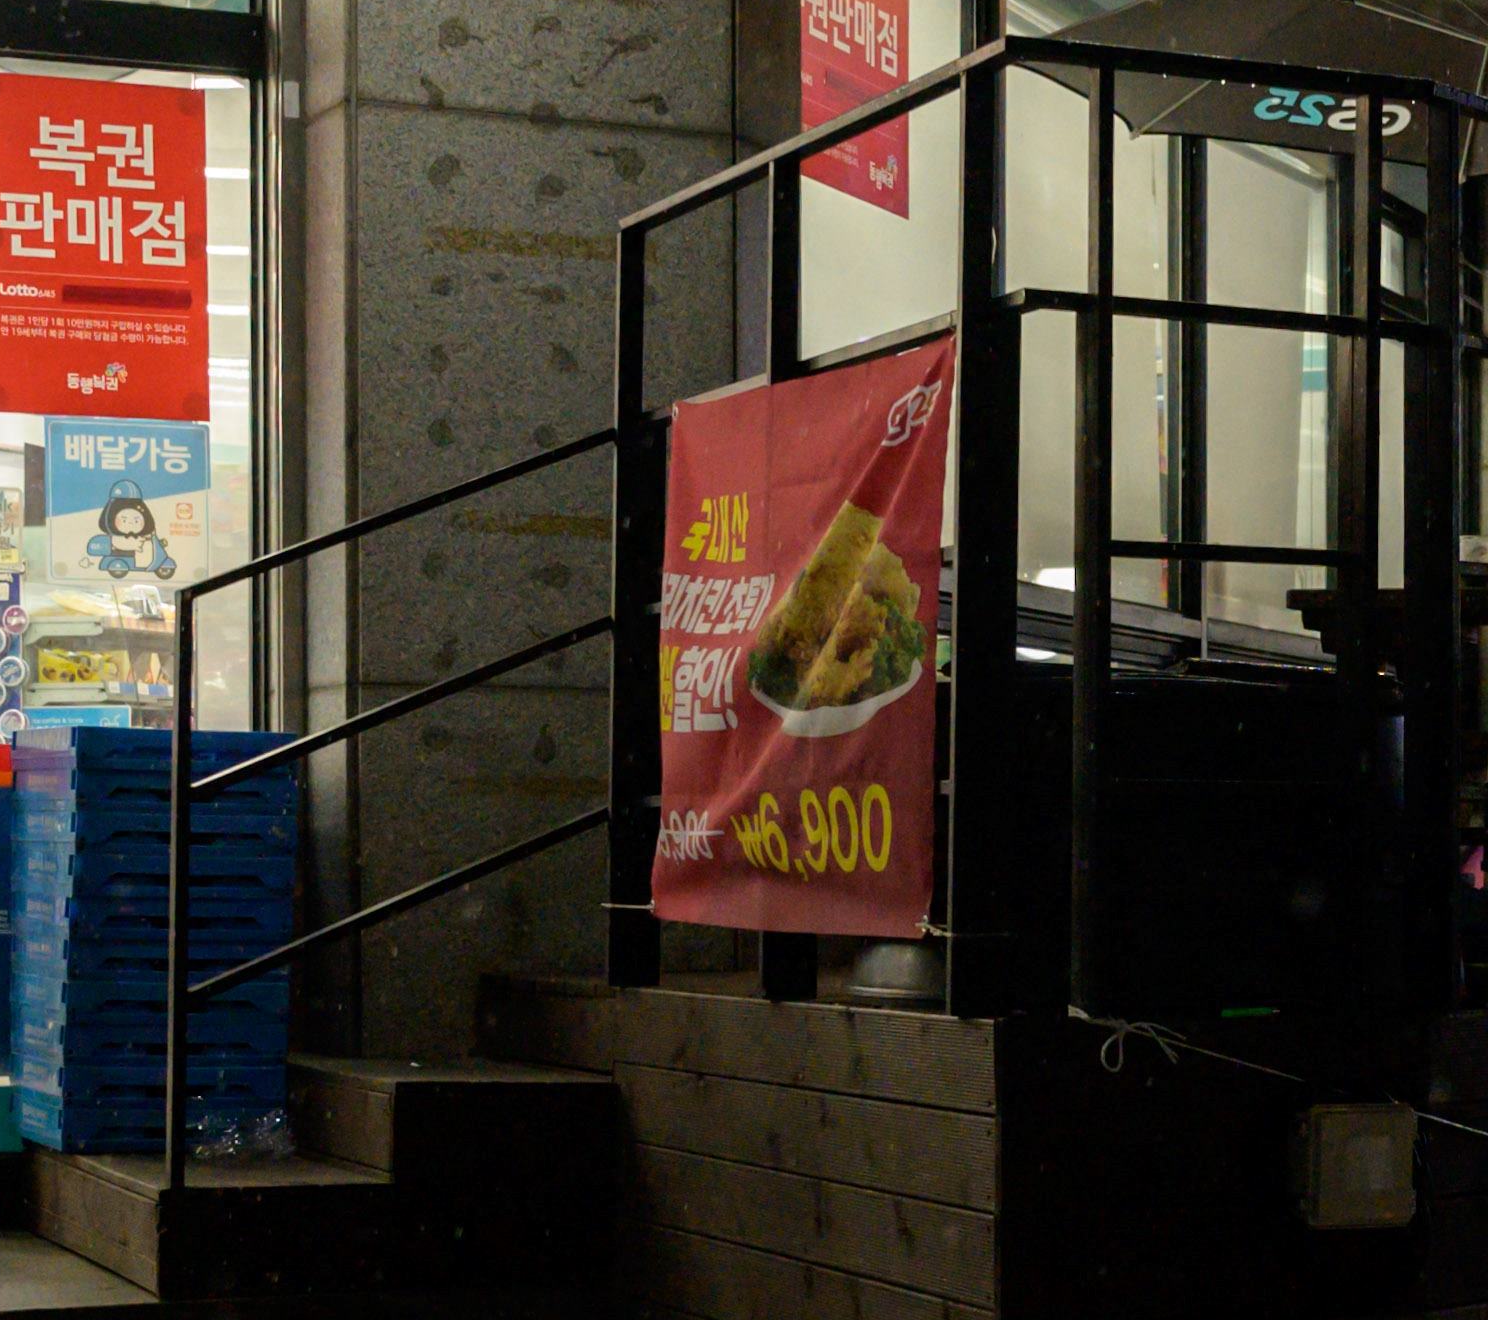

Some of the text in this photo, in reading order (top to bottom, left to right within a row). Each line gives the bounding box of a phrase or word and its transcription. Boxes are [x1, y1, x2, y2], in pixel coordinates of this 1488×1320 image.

[30, 116, 156, 191] 복권
[64, 433, 192, 475] 배달가능
[680, 491, 749, 564] 국내산
[731, 783, 893, 882] ₩6,900
